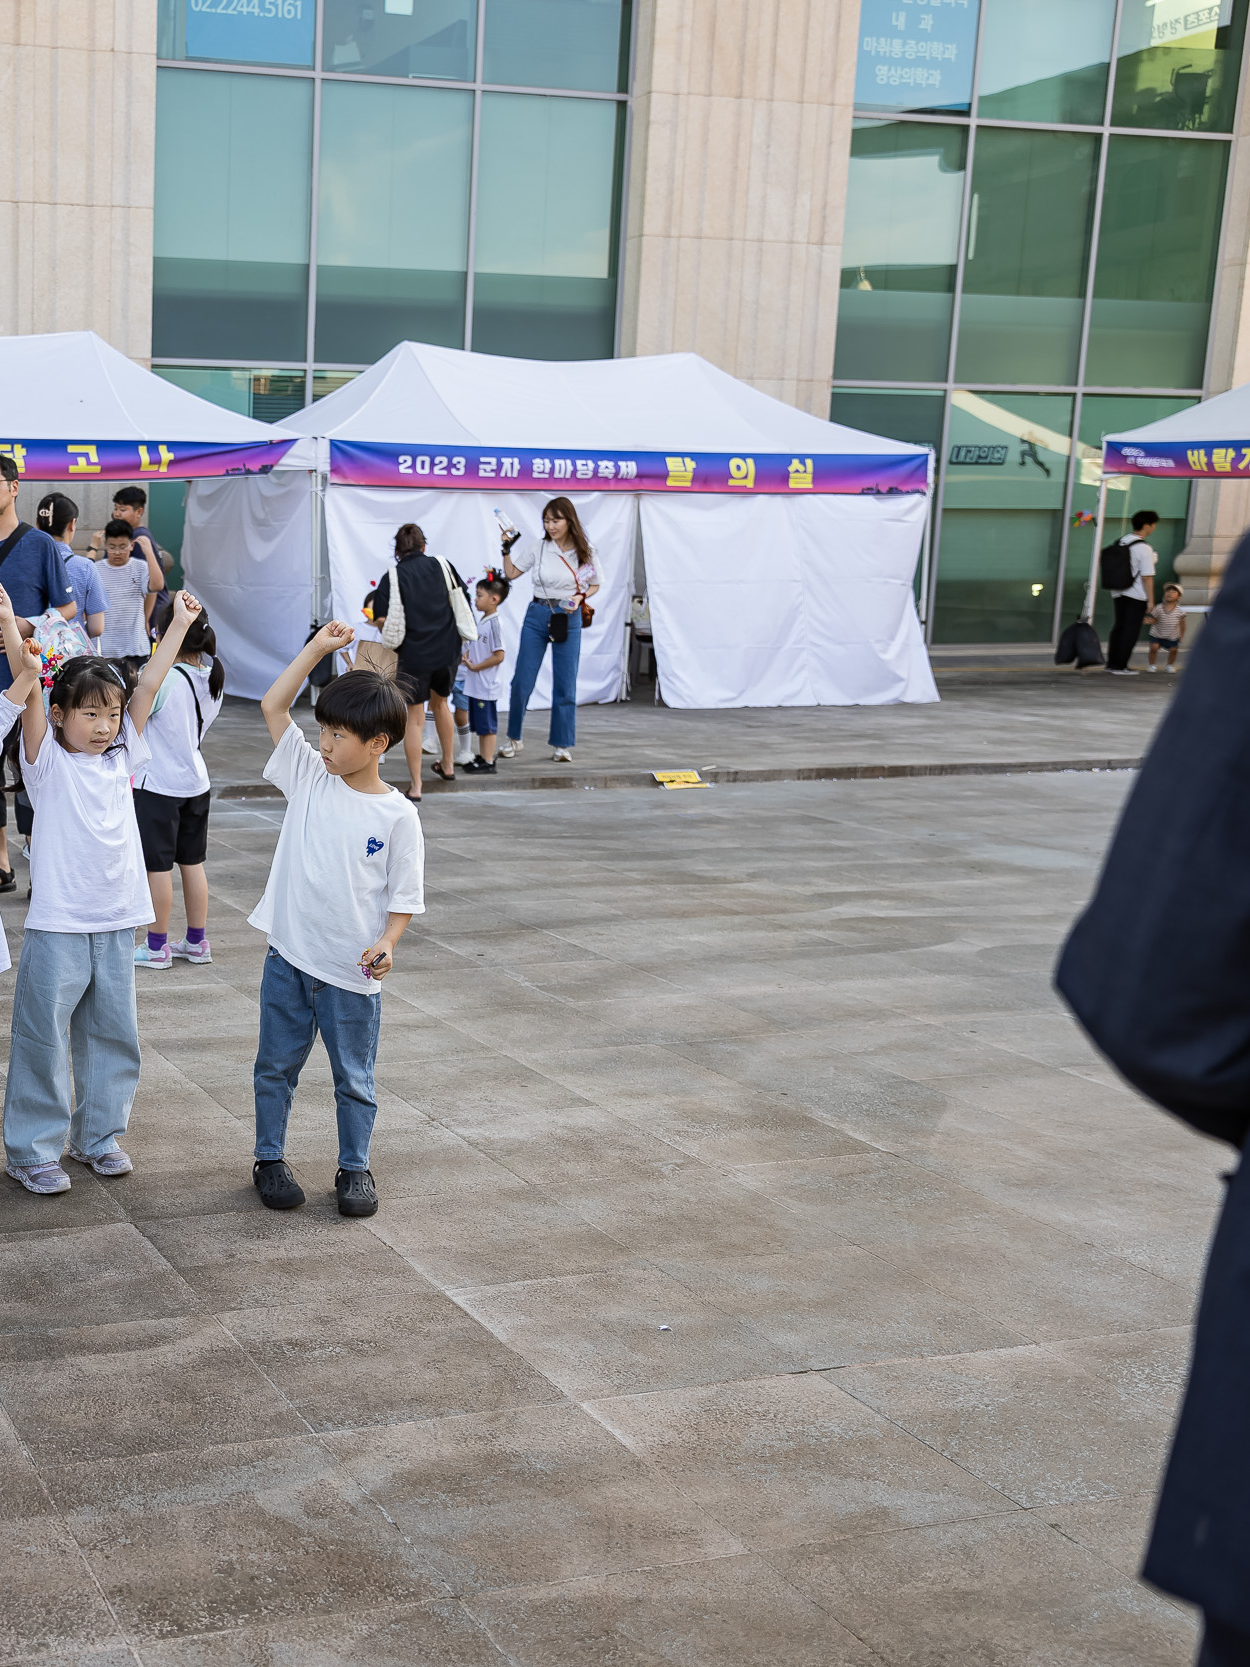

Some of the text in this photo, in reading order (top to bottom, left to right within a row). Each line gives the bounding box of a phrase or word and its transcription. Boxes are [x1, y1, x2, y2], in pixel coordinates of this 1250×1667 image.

[191, 0, 302, 19] 02.2244.5161
[875, 65, 941, 88] 영상의학과
[398, 455, 466, 476] 2023
[478, 456, 521, 478] 군자
[532, 458, 638, 480] 한마당축제
